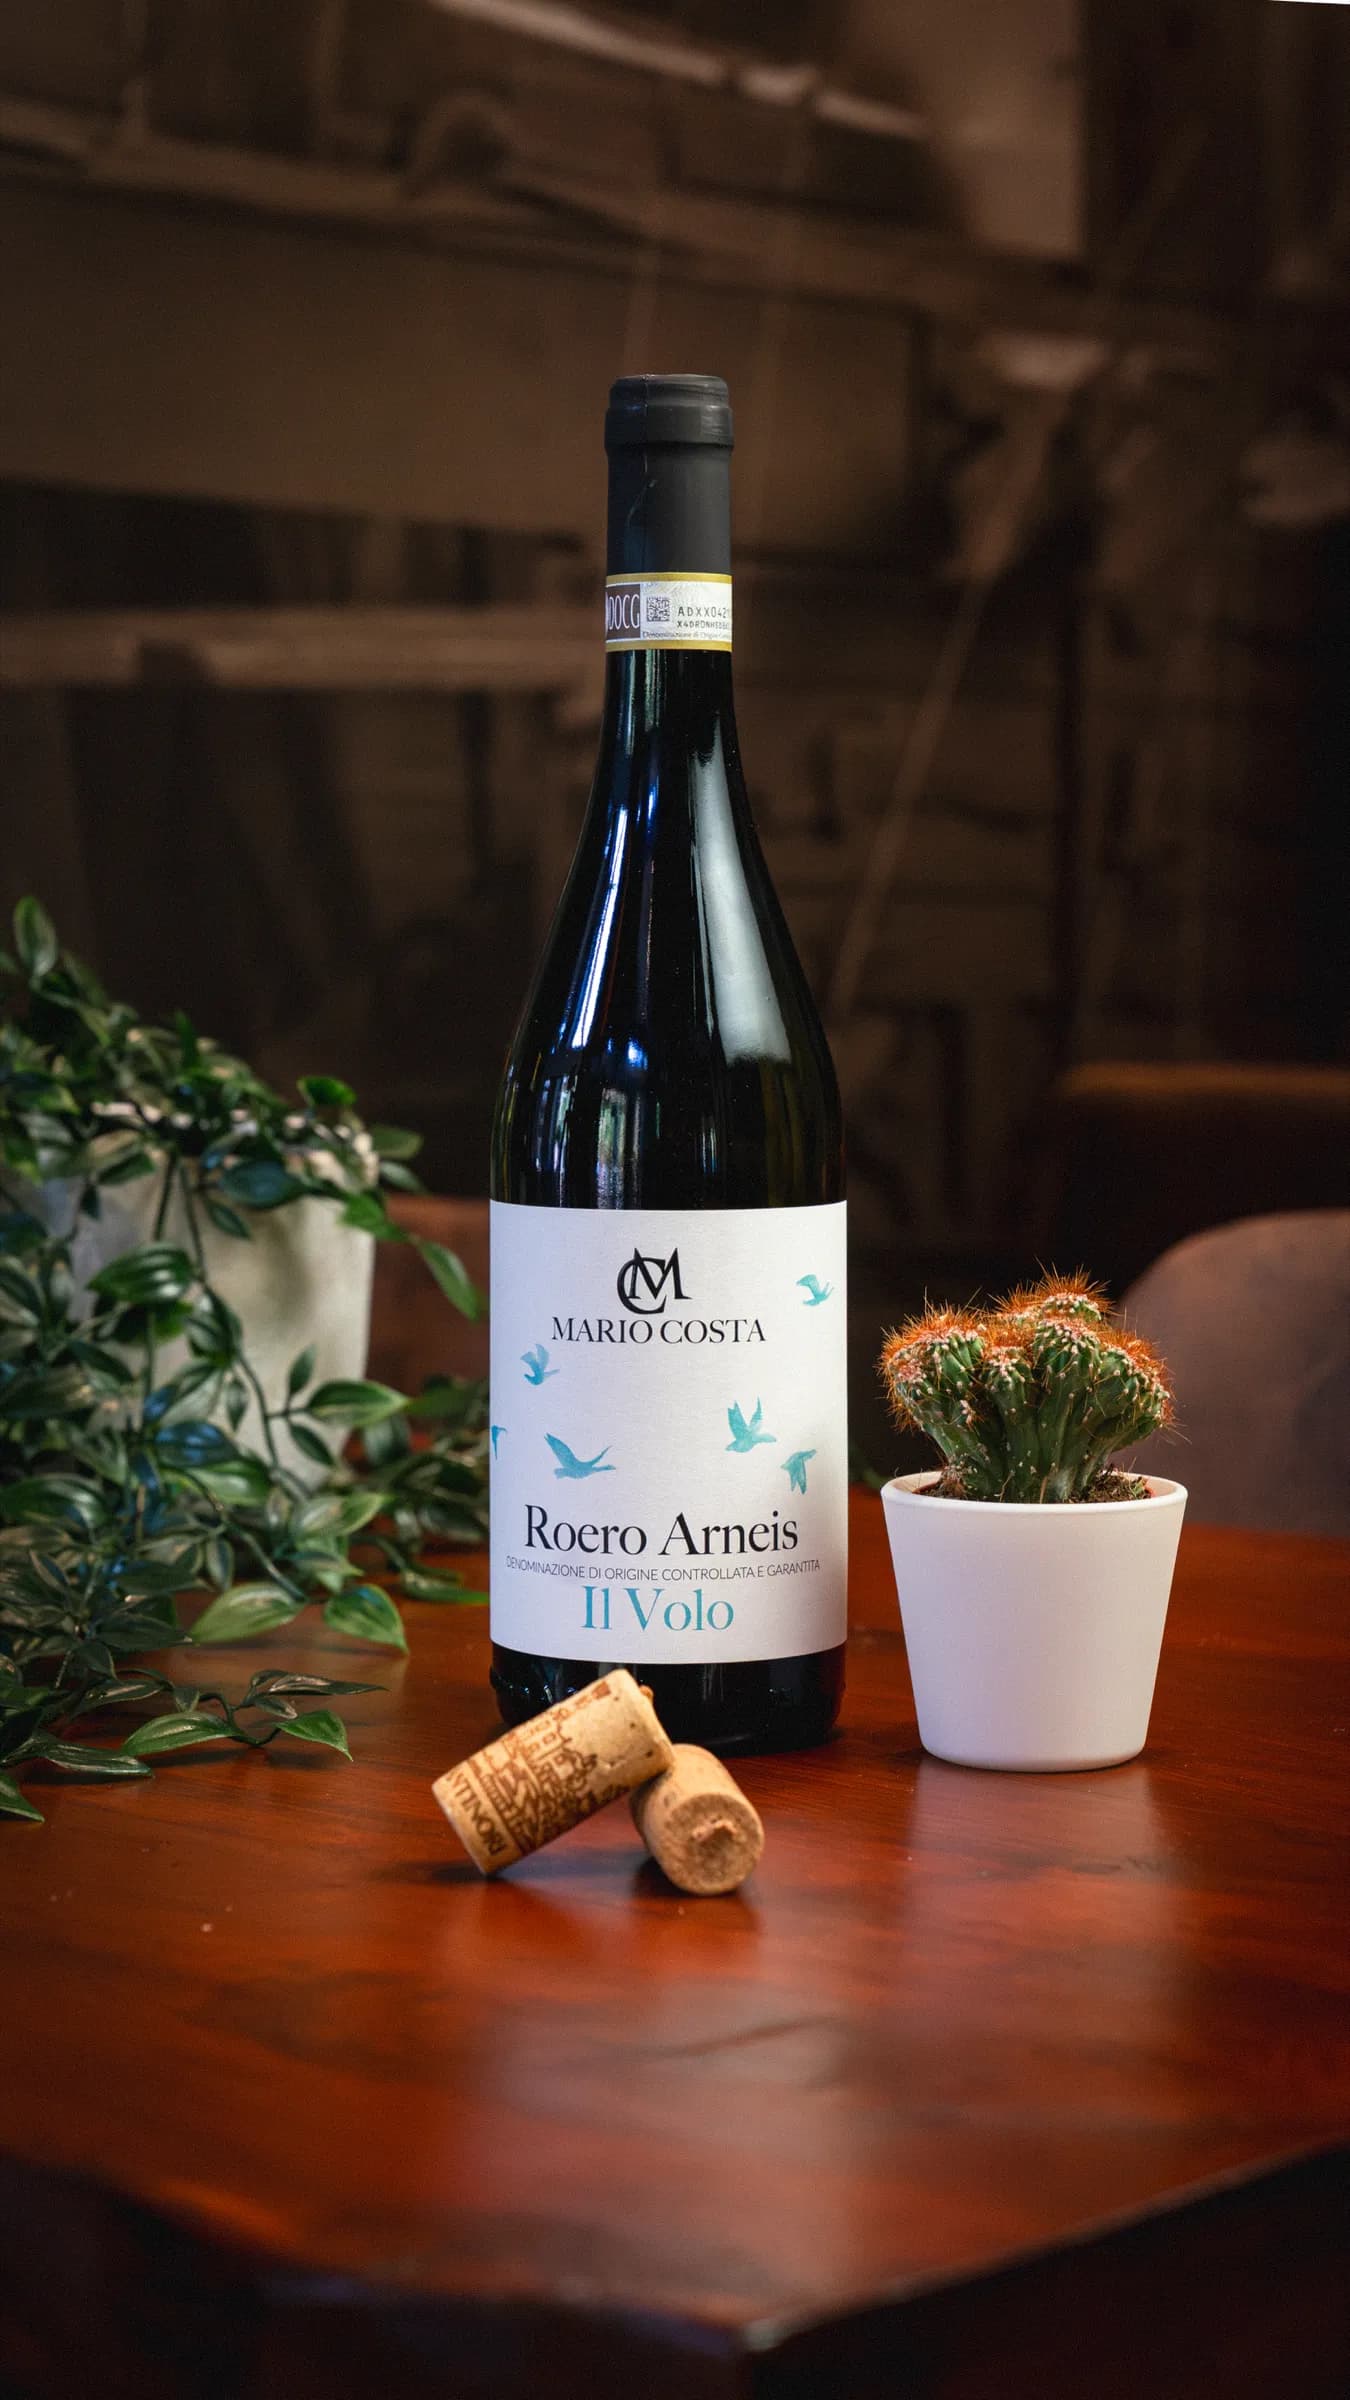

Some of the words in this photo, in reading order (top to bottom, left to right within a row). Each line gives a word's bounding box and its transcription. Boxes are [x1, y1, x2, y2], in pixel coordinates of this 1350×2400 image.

[608, 593, 640, 630] DOCG
[552, 1316, 653, 1344] MARIO
[660, 1318, 767, 1344] COSTA
[524, 1504, 648, 1556] Roero
[657, 1510, 799, 1556] Arneis
[506, 1555, 586, 1579] DENOMINAZIONE
[588, 1566, 602, 1580] DI
[603, 1567, 659, 1581] ORIGINE
[661, 1567, 755, 1581] CONTROLLATA
[757, 1566, 765, 1578] E
[766, 1559, 821, 1577] GARANTITA
[581, 1585, 613, 1631] Il
[623, 1588, 735, 1632] Volo
